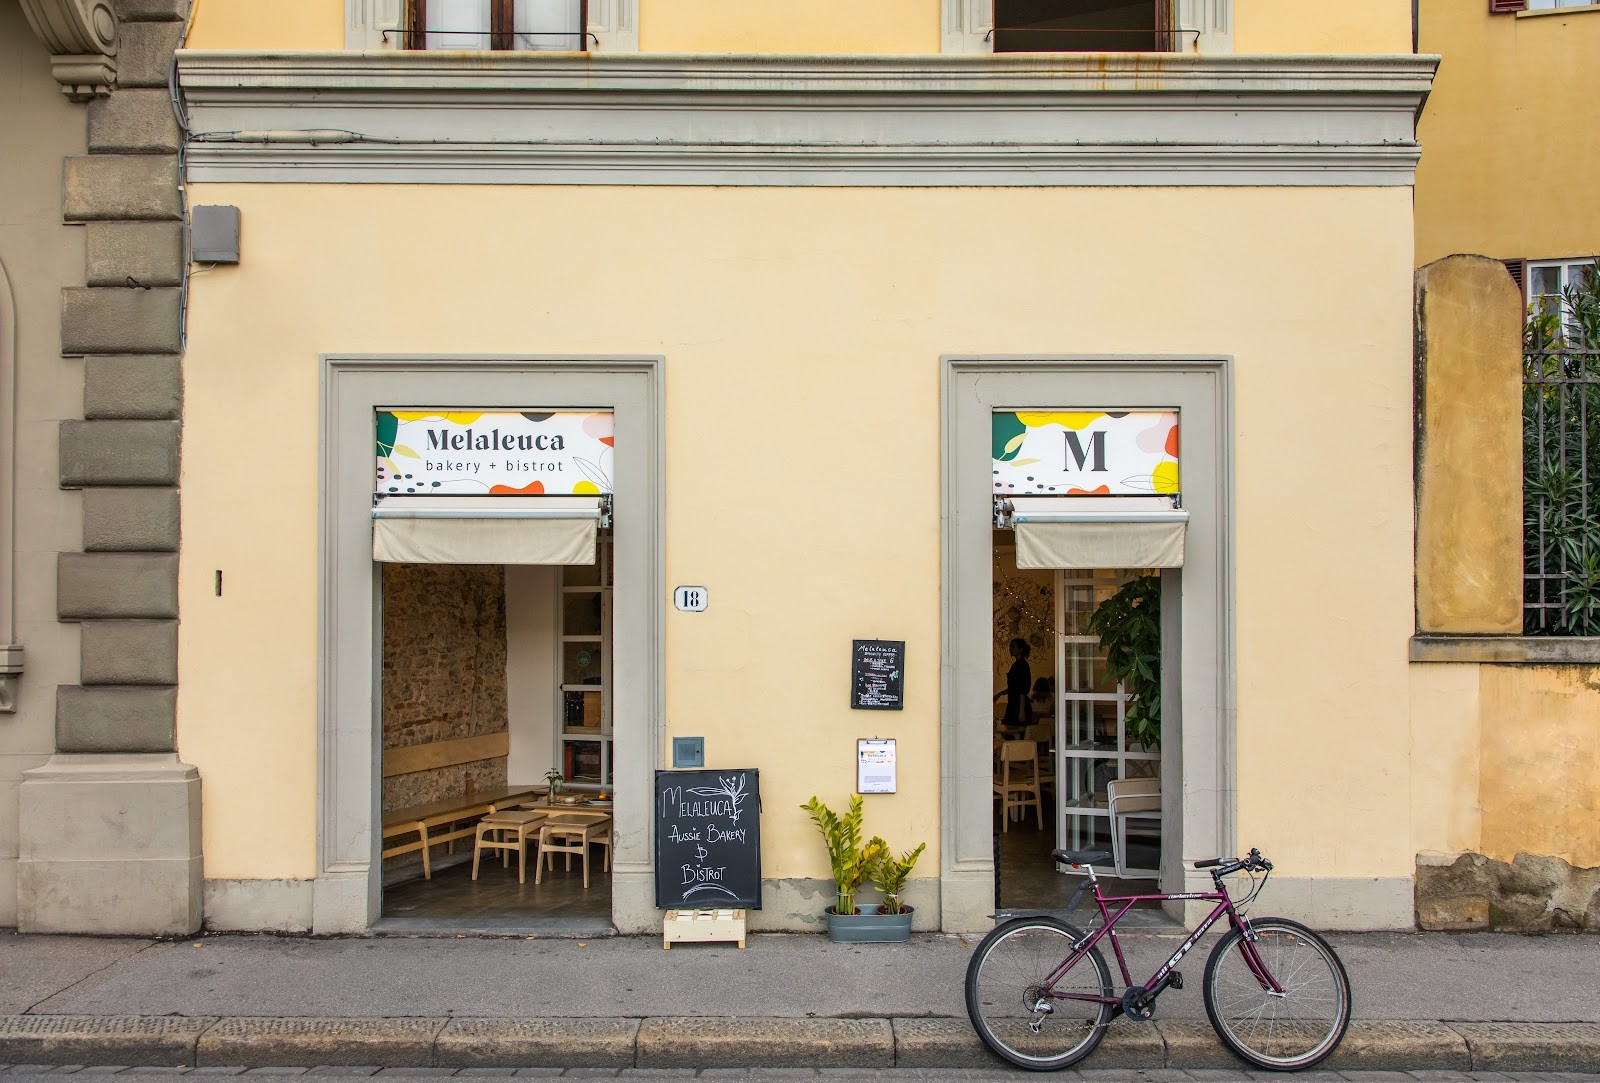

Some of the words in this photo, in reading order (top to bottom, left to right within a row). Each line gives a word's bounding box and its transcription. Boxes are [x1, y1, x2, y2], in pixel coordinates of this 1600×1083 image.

[426, 428, 565, 451] Melaleuca
[1062, 431, 1108, 472] M
[426, 459, 481, 474] bakery
[489, 462, 497, 470] +
[506, 459, 564, 472] bistrot
[683, 590, 700, 608] 18
[662, 785, 733, 818] MELALEUCA
[706, 823, 747, 845] BAKERY
[1168, 938, 1193, 968] GT
